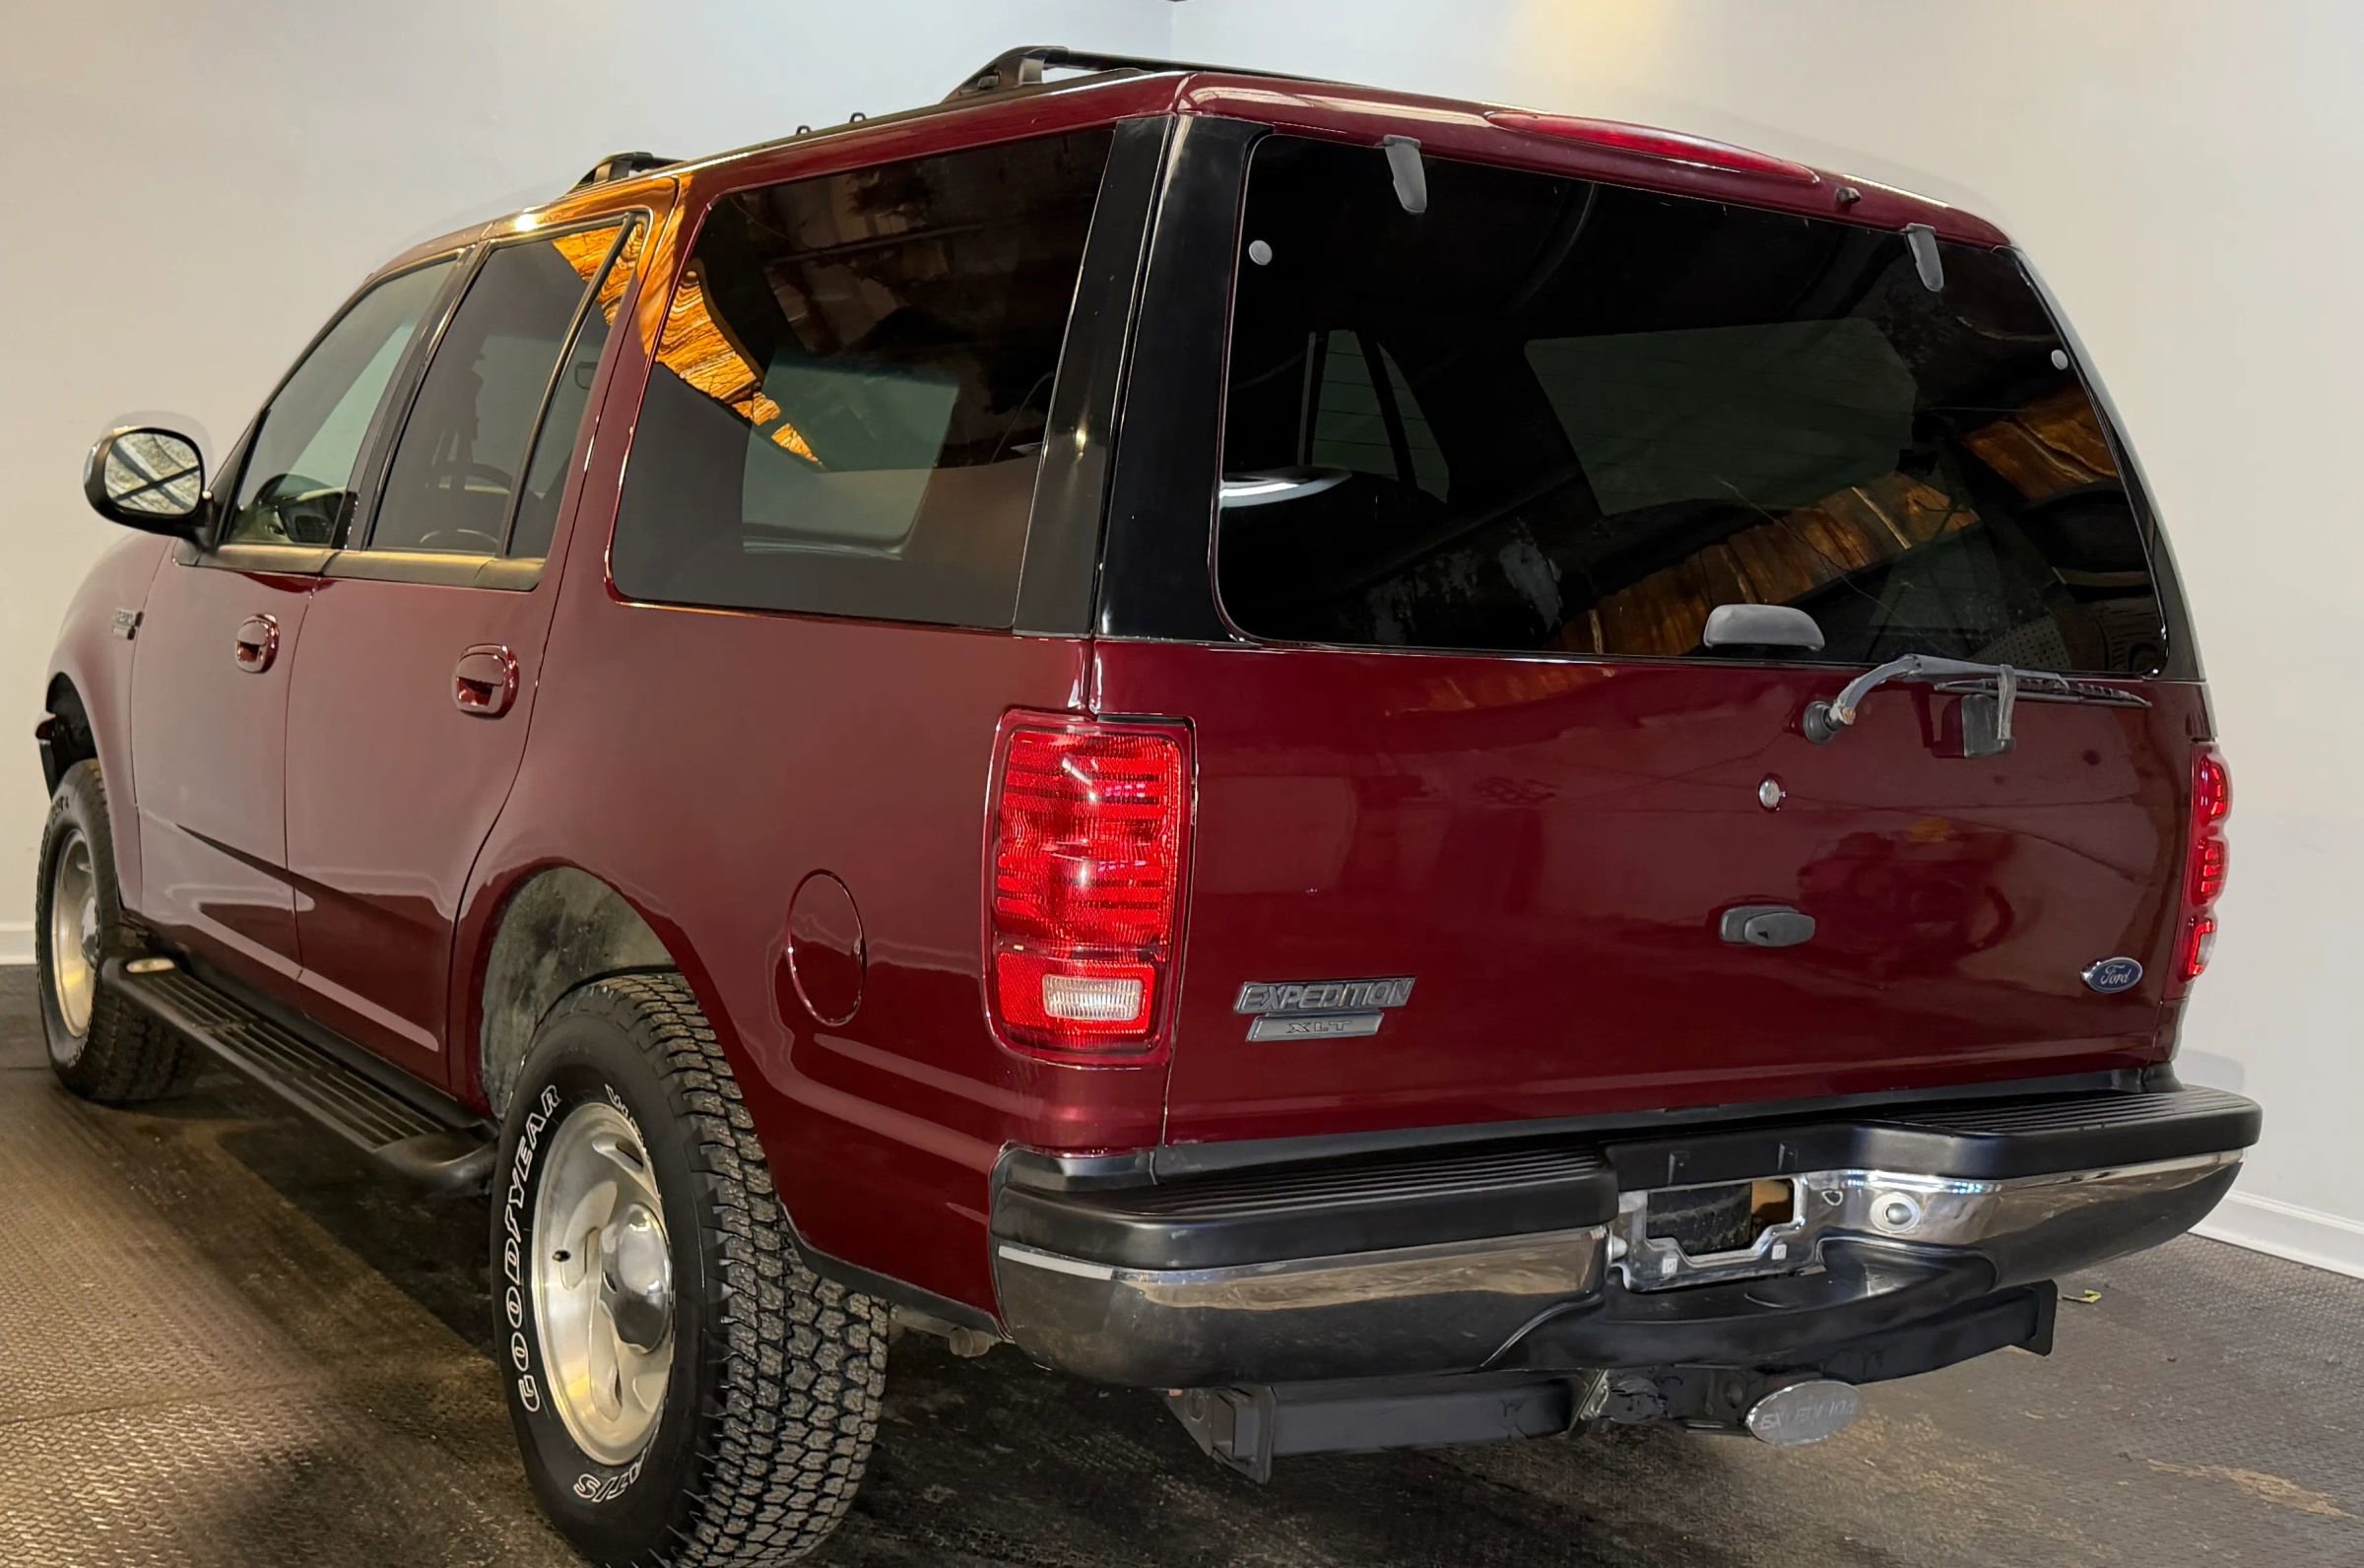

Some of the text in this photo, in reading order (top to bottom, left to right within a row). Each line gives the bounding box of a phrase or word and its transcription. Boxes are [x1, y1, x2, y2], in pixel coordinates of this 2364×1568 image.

[2100, 964, 2132, 985] Ford
[1239, 979, 1412, 1011] EXPEDITION
[1285, 1020, 1352, 1033] XLT
[504, 1084, 561, 1411] GOODYEAR
